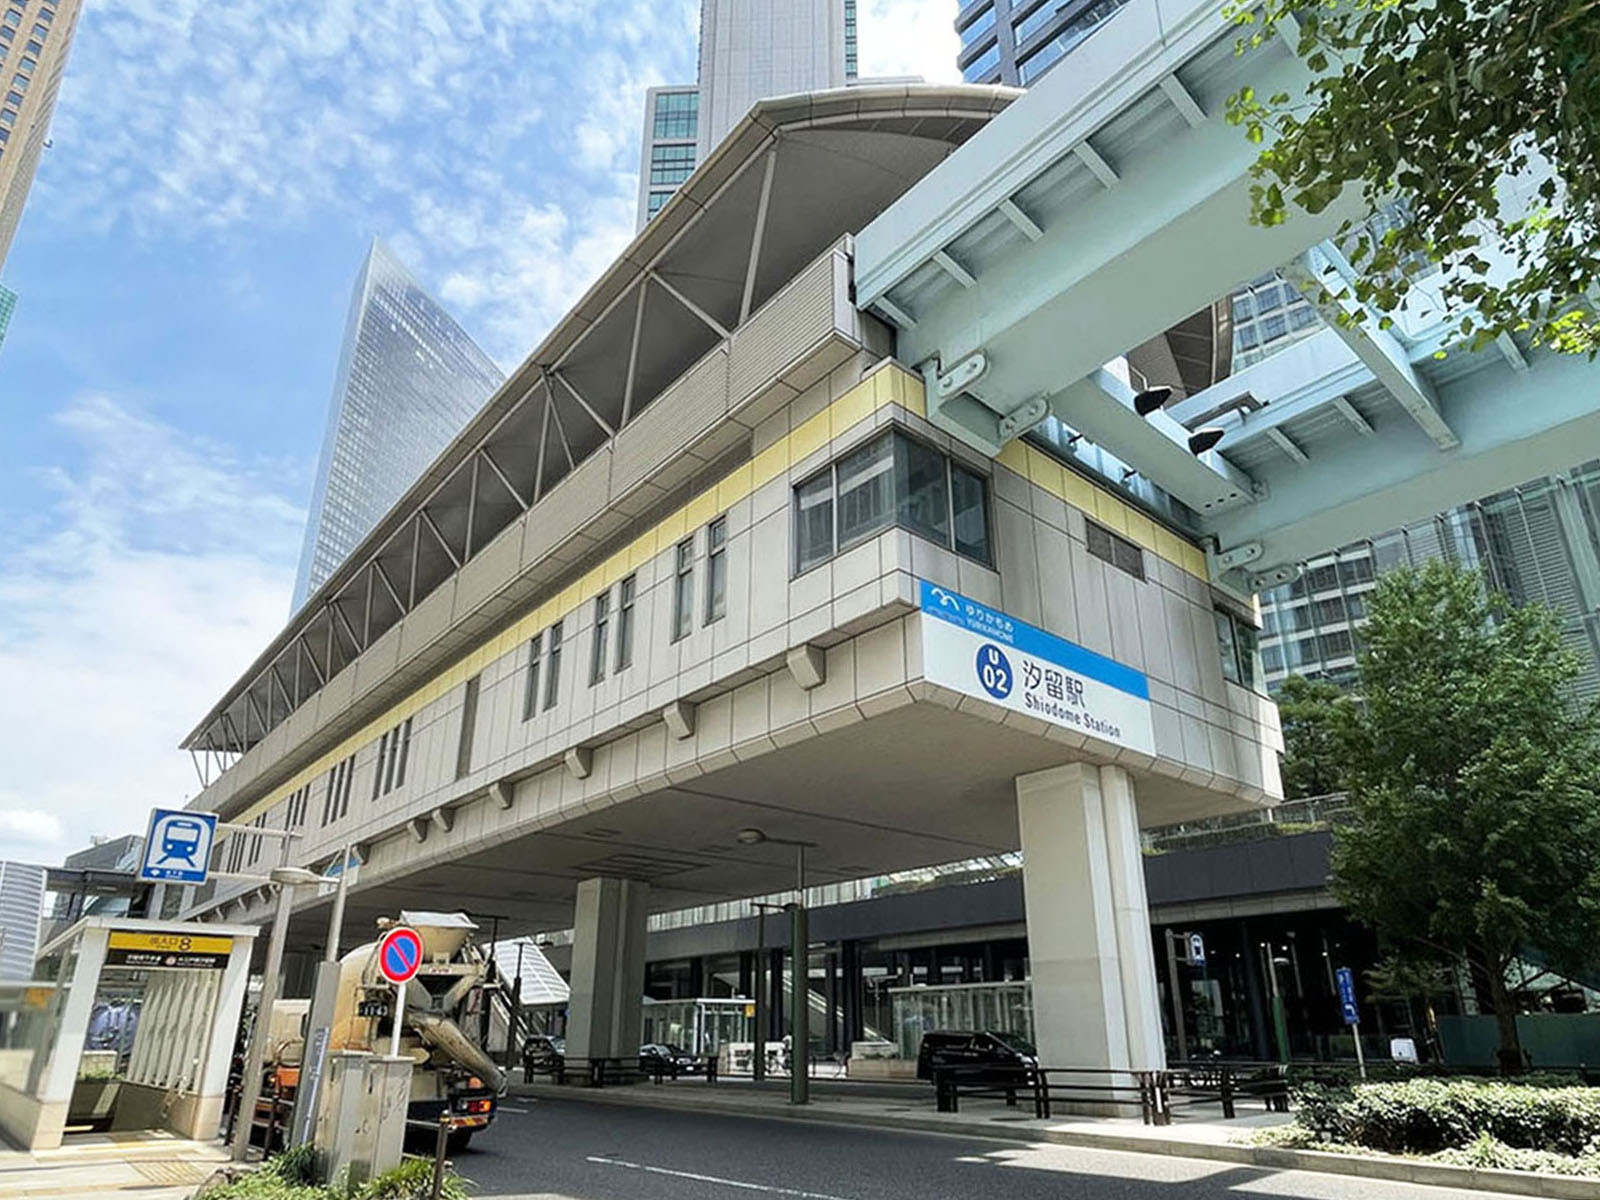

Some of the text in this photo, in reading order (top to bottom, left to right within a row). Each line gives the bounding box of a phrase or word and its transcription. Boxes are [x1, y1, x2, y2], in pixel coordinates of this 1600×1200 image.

[966, 604, 1014, 633] ゆりかもめ
[988, 648, 999, 665] U
[983, 664, 1008, 694] 02
[1022, 659, 1086, 708] 汐留駅
[1024, 691, 1121, 738] Shiodome Station
[178, 935, 192, 952] 8
